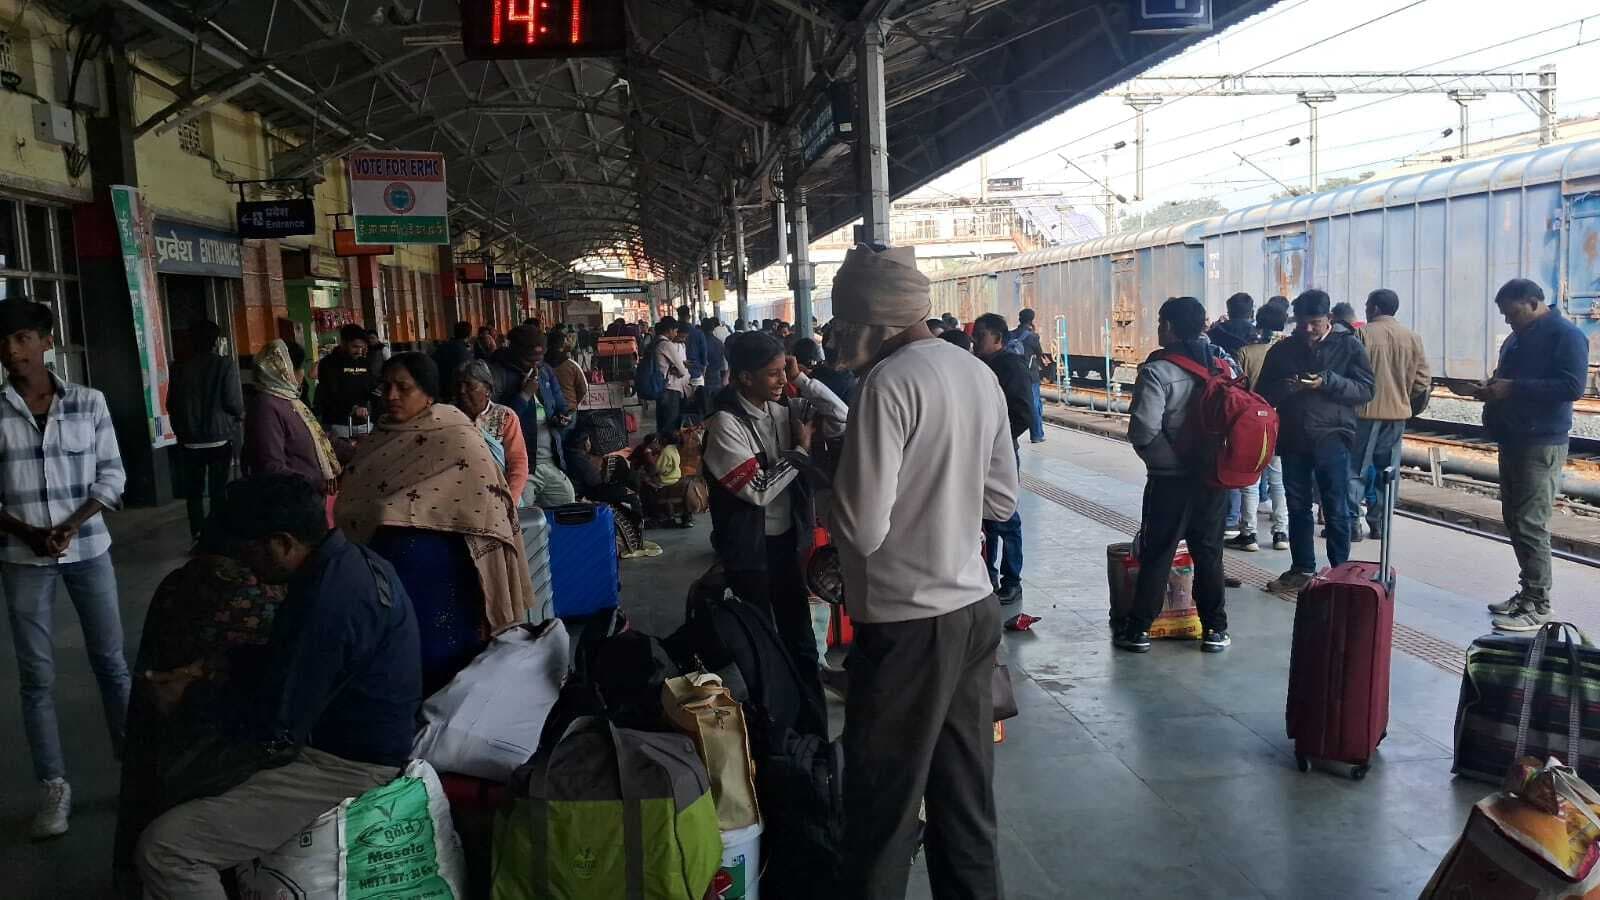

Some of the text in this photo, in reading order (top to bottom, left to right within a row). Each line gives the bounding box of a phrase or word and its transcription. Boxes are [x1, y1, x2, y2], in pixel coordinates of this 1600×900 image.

[354, 158, 439, 176] VOTE FOR ERMC
[265, 219, 305, 229] Entrance
[154, 229, 193, 264] प्रवेश
[200, 237, 240, 266] ENTRANCE
